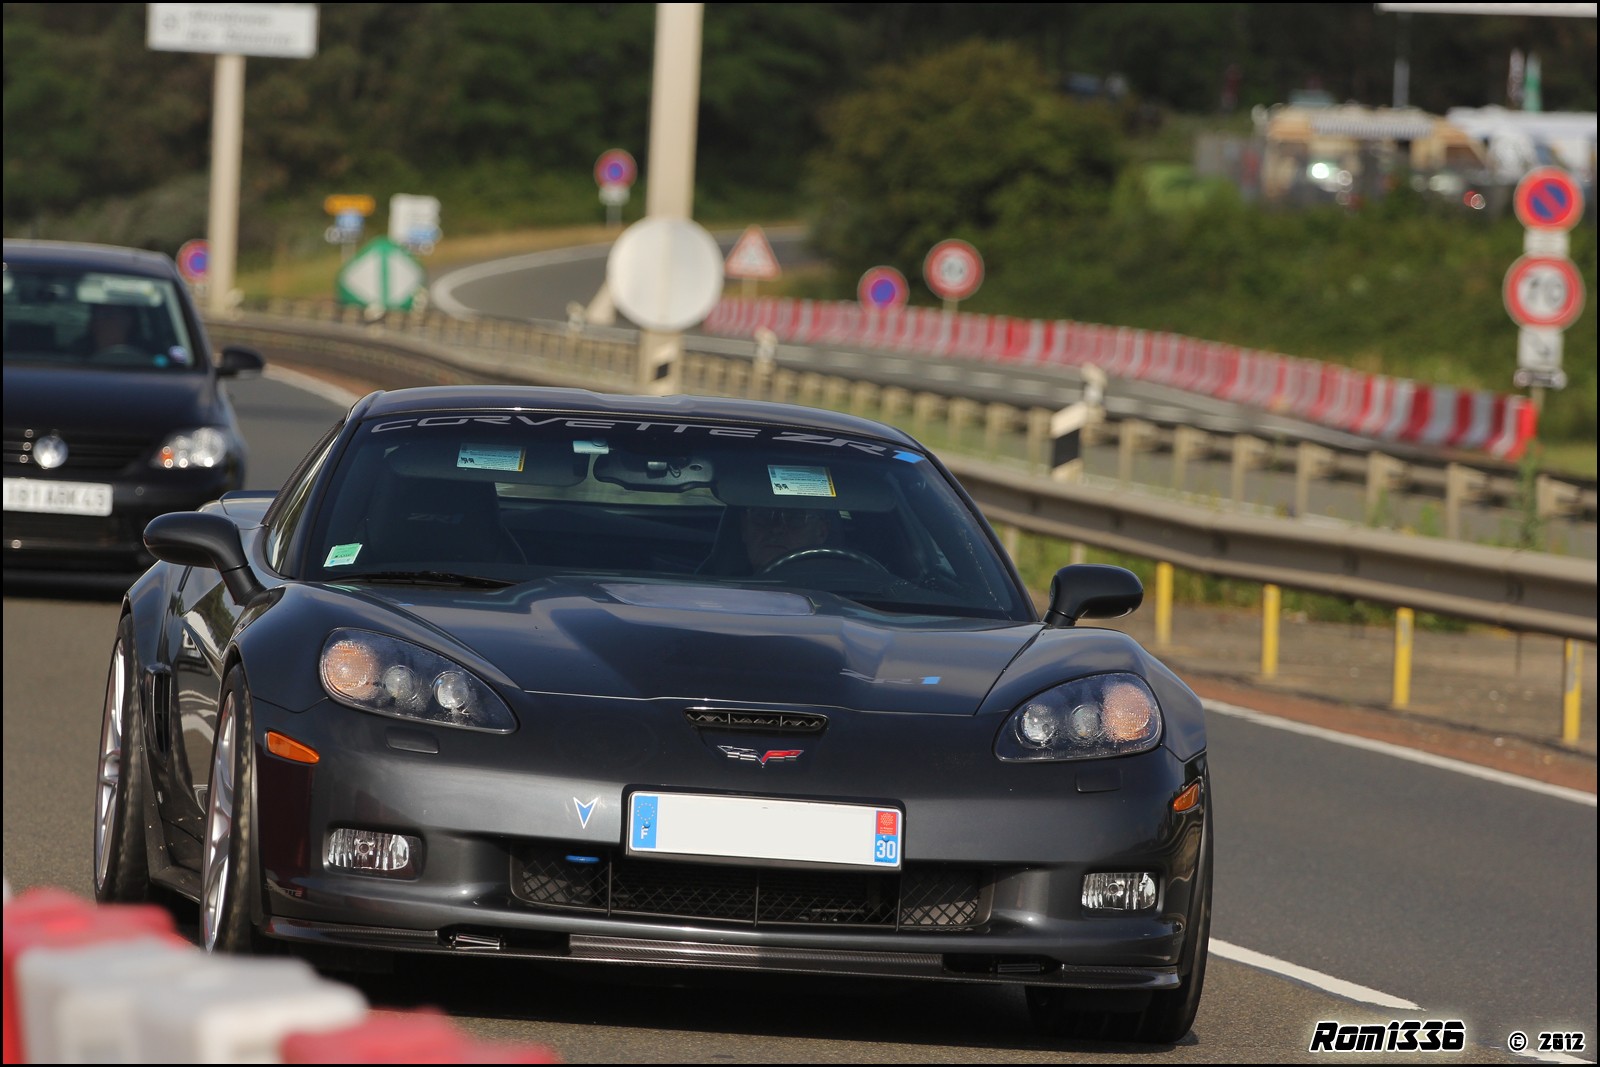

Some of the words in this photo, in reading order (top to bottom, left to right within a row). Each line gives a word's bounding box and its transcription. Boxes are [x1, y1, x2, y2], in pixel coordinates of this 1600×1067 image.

[371, 415, 761, 438] CORVETTE
[772, 431, 925, 464] ZR1
[640, 825, 649, 840] F
[876, 840, 897, 859] 30
